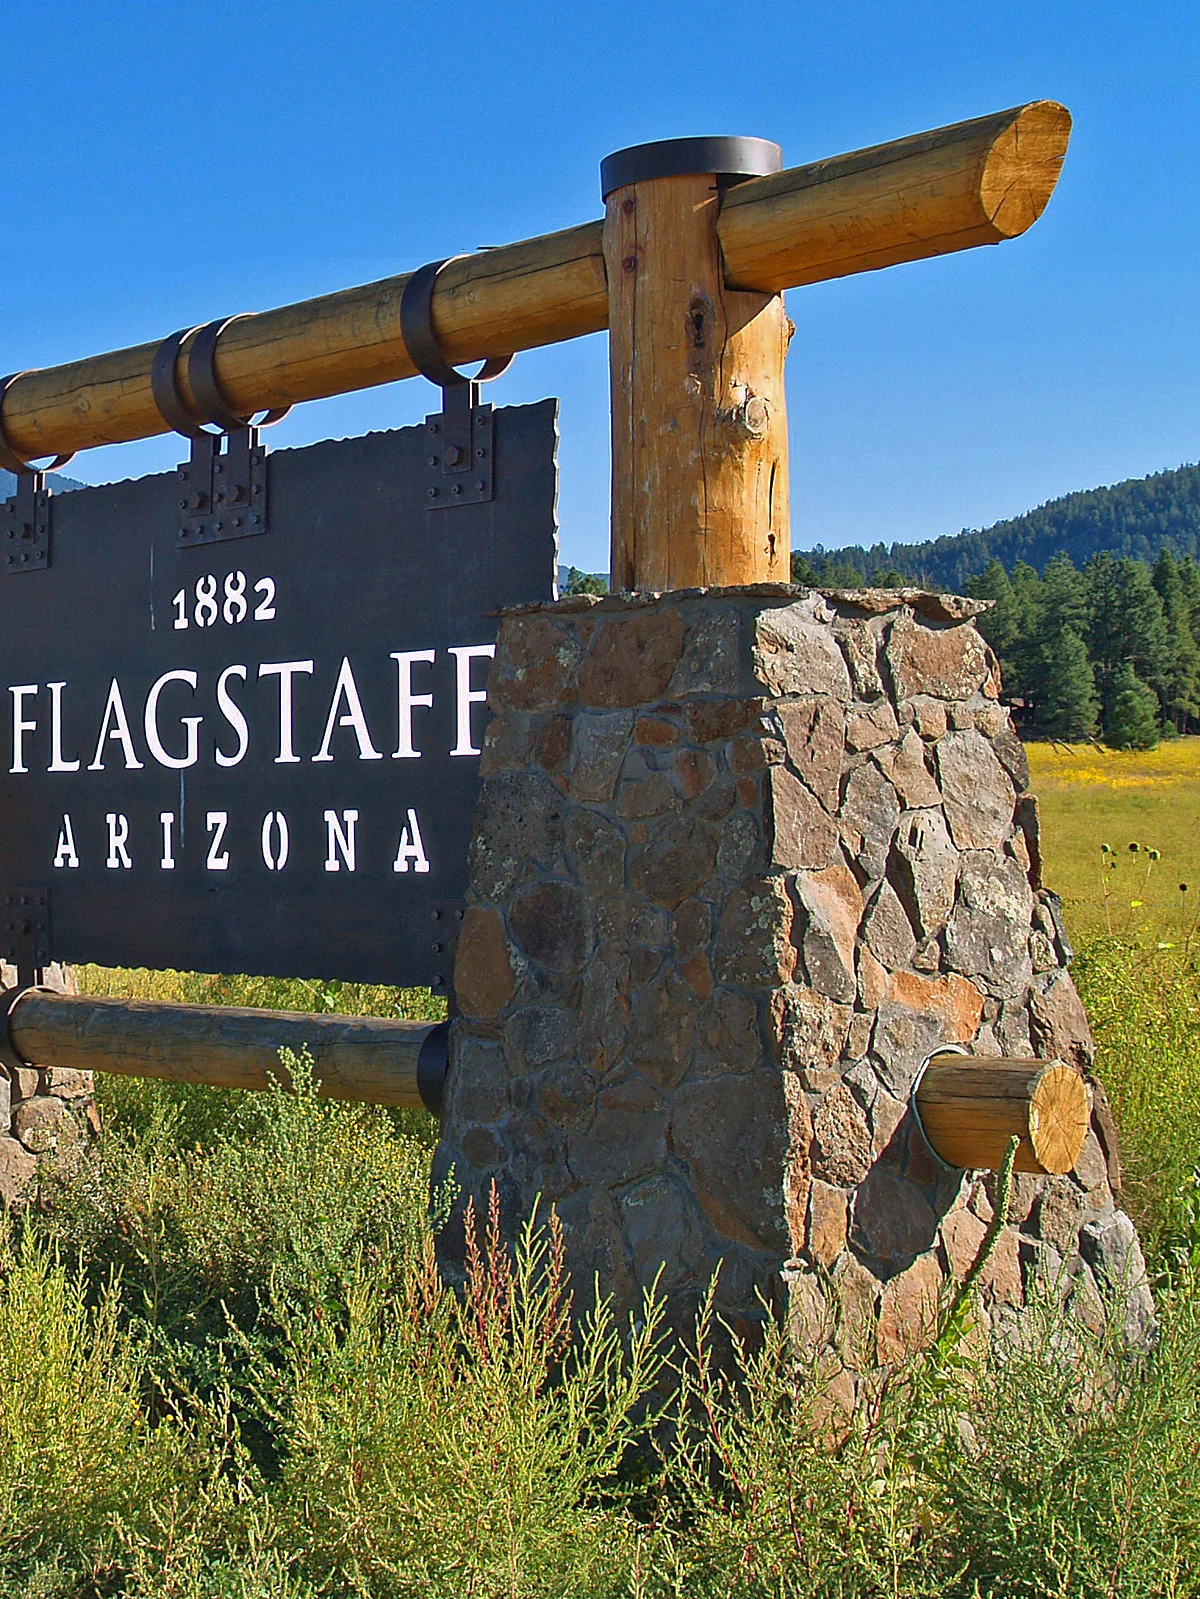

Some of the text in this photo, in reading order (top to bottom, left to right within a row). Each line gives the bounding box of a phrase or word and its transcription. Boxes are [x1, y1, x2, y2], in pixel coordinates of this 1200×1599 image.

[172, 570, 276, 630] 1882
[8, 644, 496, 774] FLAGSTAFF
[53, 808, 430, 873] ARIZONA
